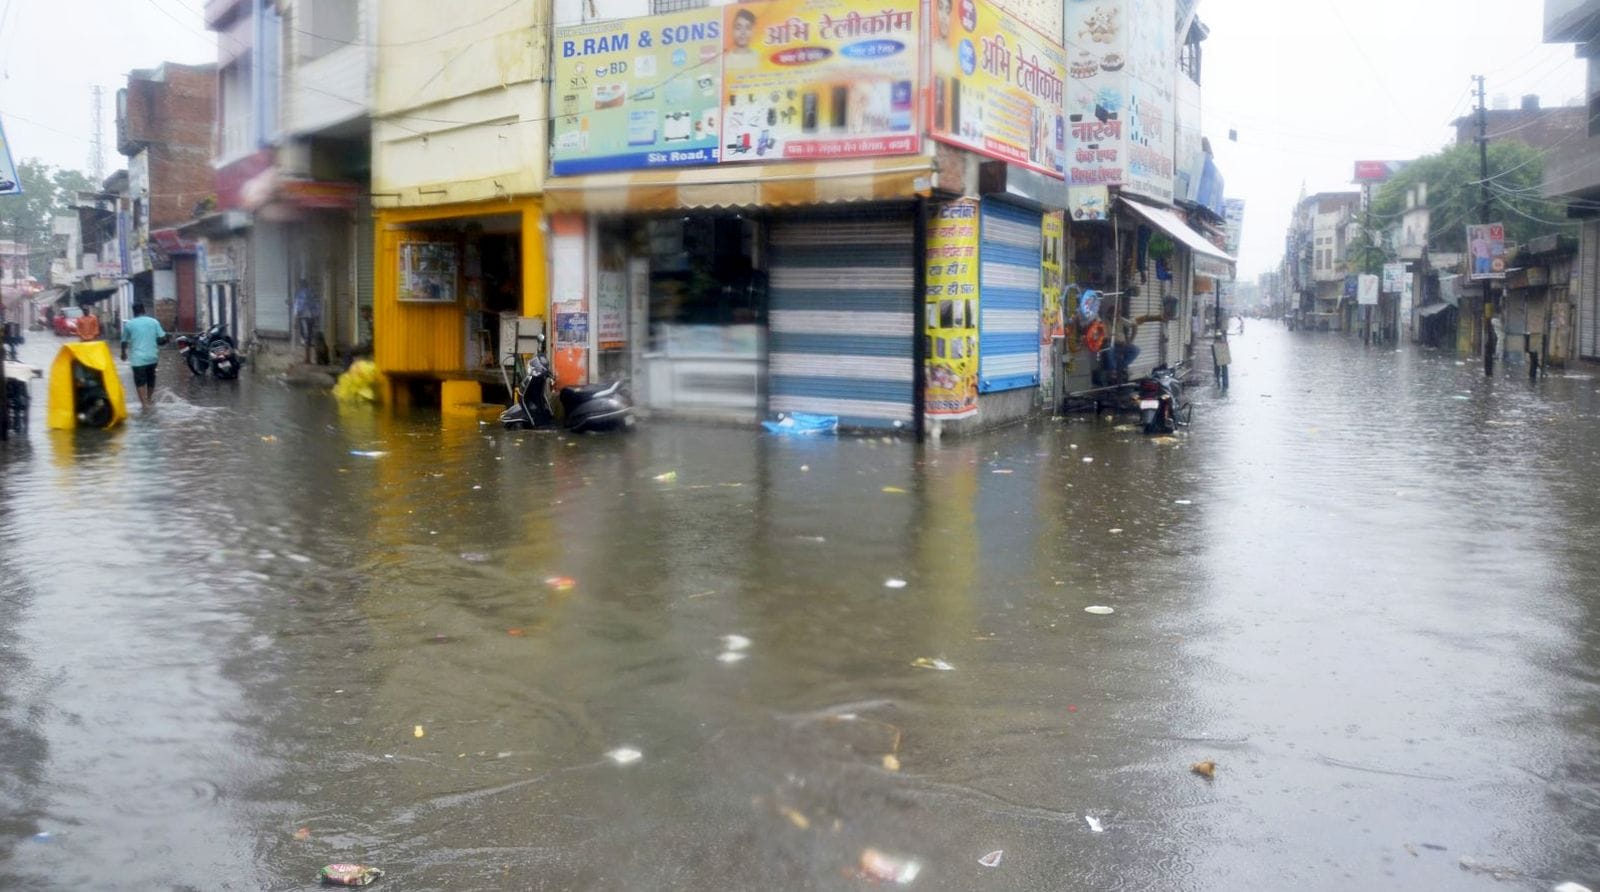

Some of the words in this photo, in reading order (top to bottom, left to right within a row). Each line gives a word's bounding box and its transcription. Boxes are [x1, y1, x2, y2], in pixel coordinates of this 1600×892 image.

[563, 33, 629, 58] B.RAM
[638, 30, 652, 48] &
[661, 21, 720, 45] SONS
[765, 18, 810, 45] अभि
[819, 9, 913, 40] टेलीकॉम
[609, 61, 628, 75] BD
[981, 34, 1011, 82] अभि
[1016, 43, 1064, 109] टेलीकॉम
[648, 152, 668, 163] Six
[671, 149, 708, 162] Road,
